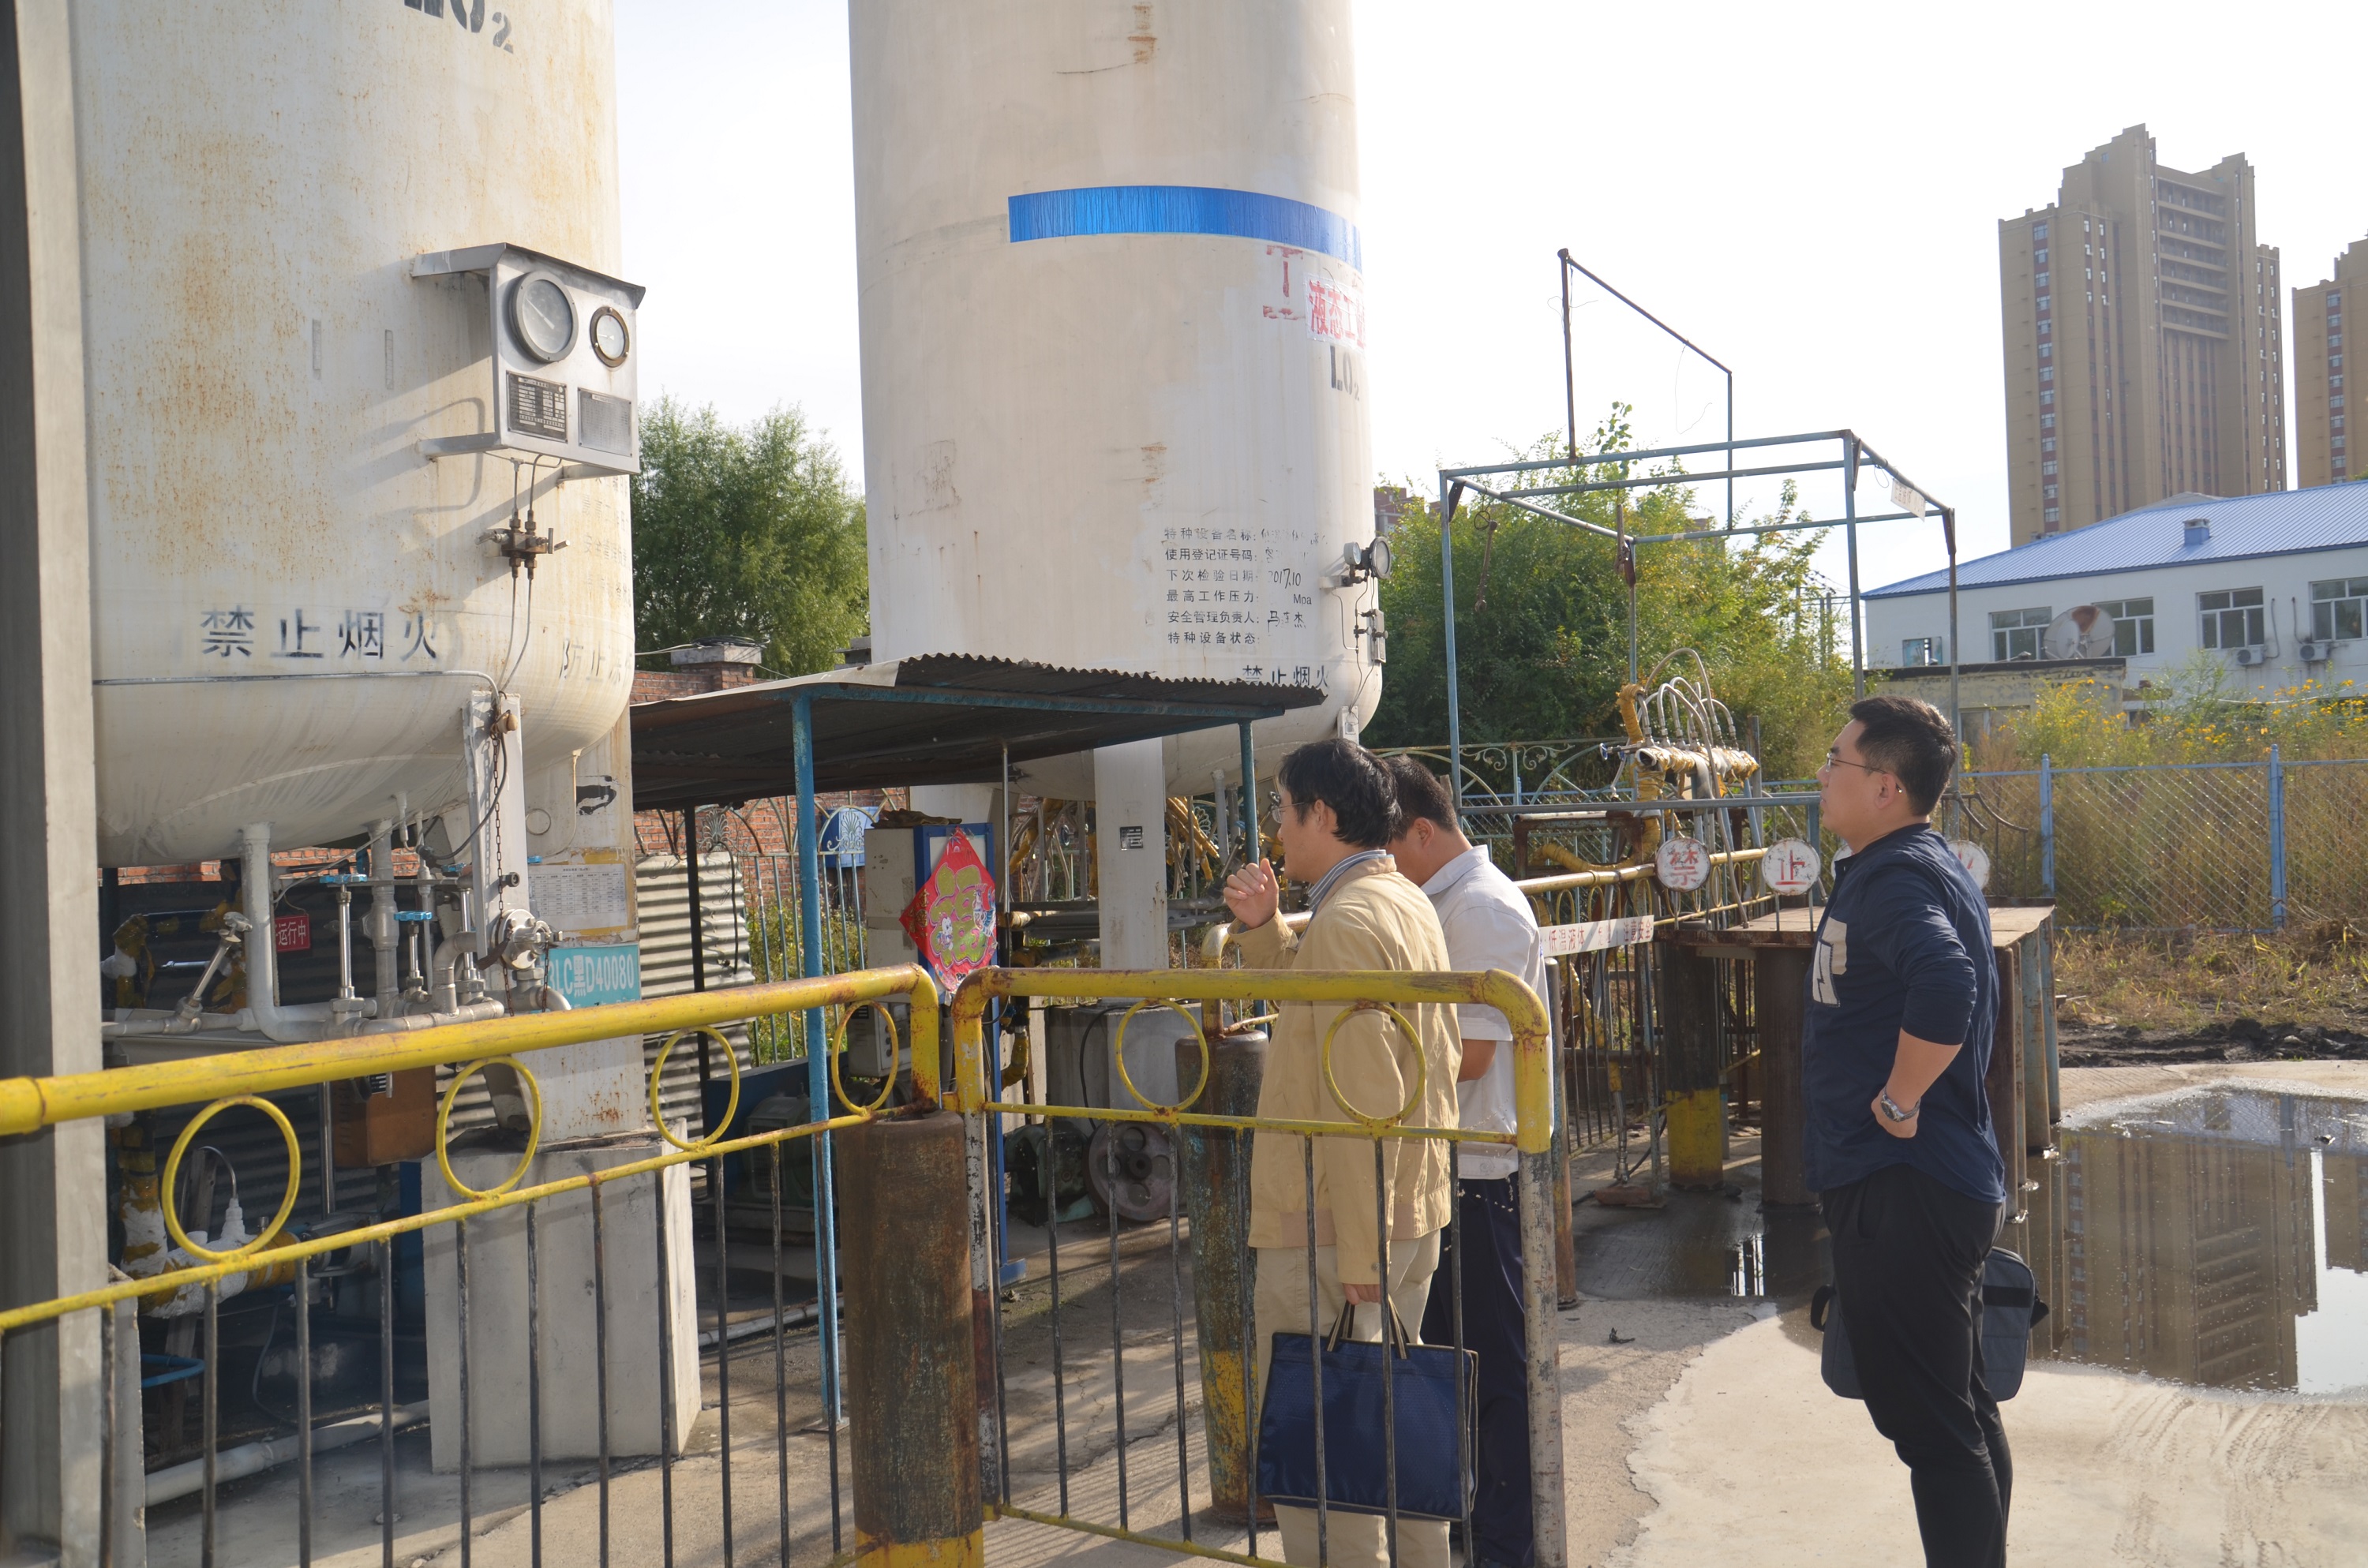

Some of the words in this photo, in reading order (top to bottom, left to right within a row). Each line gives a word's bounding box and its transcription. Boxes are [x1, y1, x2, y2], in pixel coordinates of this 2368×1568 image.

[1165, 548, 1257, 561] 使用登记证号码：
[1166, 568, 1257, 582] 下次检验日期：
[1167, 589, 1258, 603] 最高工作压力：
[1293, 593, 1312, 605] Mpa
[1168, 610, 1259, 623] 安全管理负责人：
[200, 604, 437, 662] 禁止烟火
[1670, 849, 1699, 886] 禁
[1775, 849, 1808, 885] 止
[275, 919, 307, 946] 运行中
